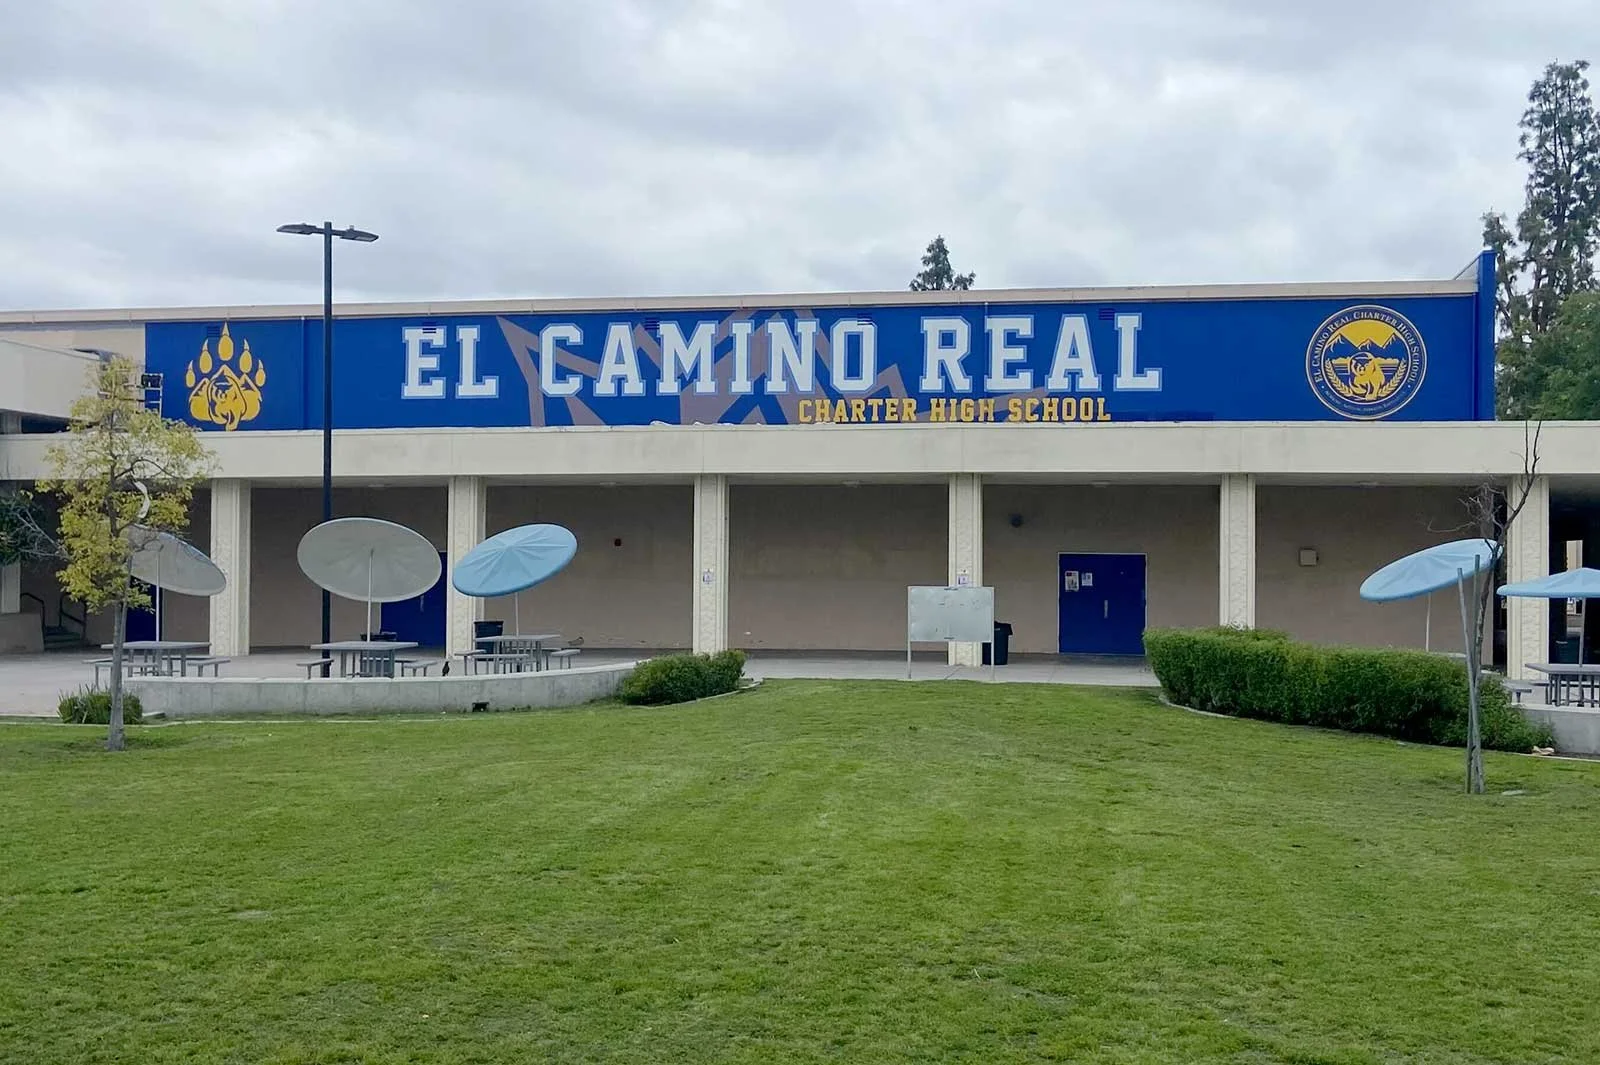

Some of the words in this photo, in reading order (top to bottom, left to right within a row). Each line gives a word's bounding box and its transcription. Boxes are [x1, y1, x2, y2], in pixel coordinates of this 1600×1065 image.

[1327, 316, 1352, 333] REAL
[1353, 311, 1398, 327] CHARTER
[1397, 323, 1416, 346] HIGH
[401, 324, 499, 399] EL
[539, 317, 878, 397] CAMINO
[919, 312, 1162, 393] REAL
[1311, 331, 1330, 367] CAMINO
[1313, 370, 1324, 383] EL
[1407, 345, 1420, 383] SCHOOL
[798, 398, 918, 423] CHARTER
[929, 398, 996, 422] HIGH
[1007, 396, 1112, 422] SCHOOL
